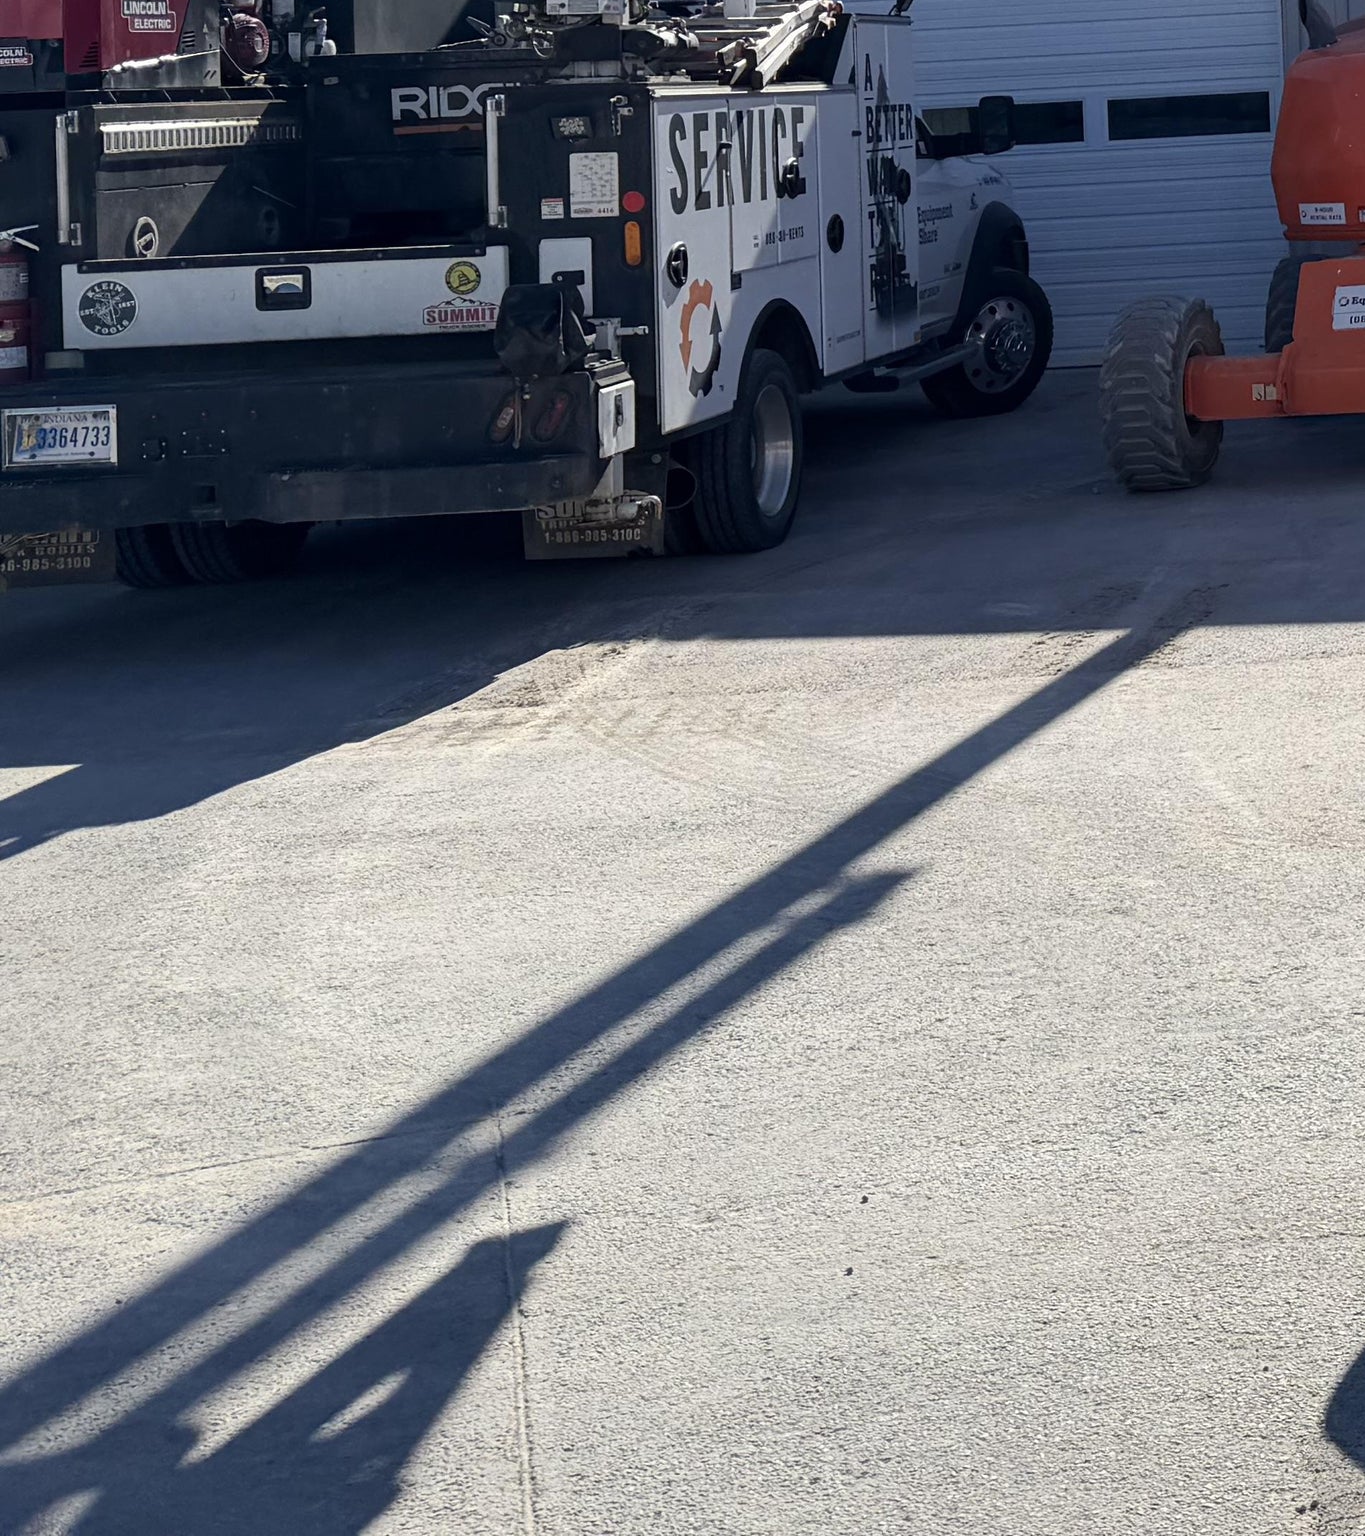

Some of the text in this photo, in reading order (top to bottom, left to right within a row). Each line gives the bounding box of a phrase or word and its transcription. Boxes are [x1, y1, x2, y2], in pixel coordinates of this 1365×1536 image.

[123, 0, 166, 15] LINCOLN
[133, 18, 172, 30] ELECTRIC
[866, 103, 913, 144] BETTER
[669, 107, 806, 215] SERVICE
[85, 282, 123, 299] KLEIN
[118, 300, 135, 309] 1857
[426, 307, 496, 323] SUMMIT
[93, 319, 130, 335] TOOLS
[43, 413, 88, 424] INDIANA
[37, 425, 110, 449] 3364733
